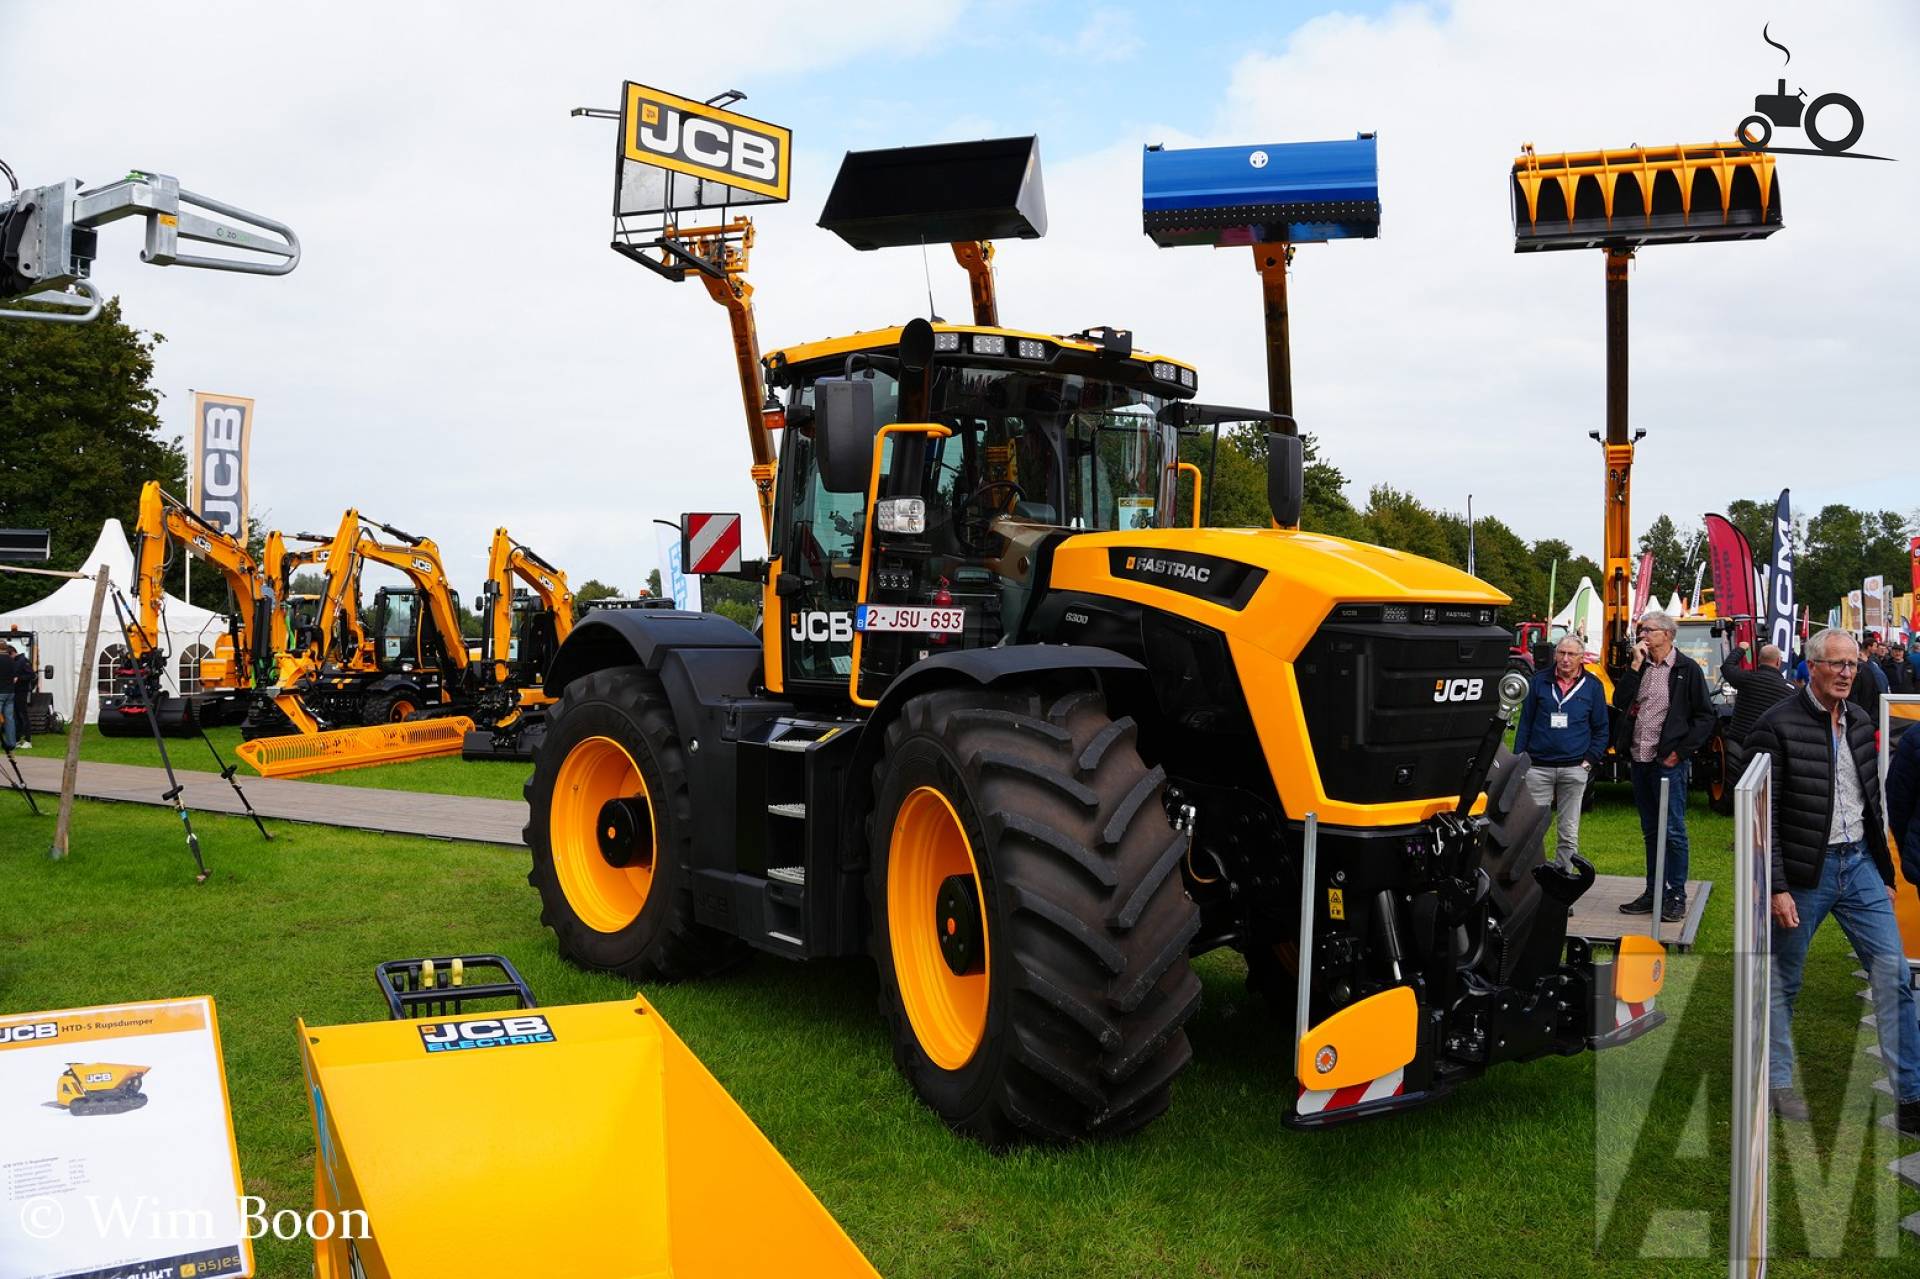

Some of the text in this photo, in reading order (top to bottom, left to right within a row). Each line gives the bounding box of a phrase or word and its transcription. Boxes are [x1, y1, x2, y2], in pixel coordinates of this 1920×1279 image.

[640, 109, 776, 180] JCB
[205, 407, 241, 535] JCB
[192, 536, 212, 551] JCB
[412, 557, 432, 572] JCB
[1136, 557, 1211, 583] FASTRAC
[540, 575, 555, 592] JCB
[791, 608, 853, 642] JCB
[1065, 612, 1089, 625] 6300
[1434, 678, 1484, 703] JCB
[423, 1017, 549, 1042] JCB
[427, 1032, 554, 1052] ELECTRIC
[86, 1073, 111, 1083] JCB
